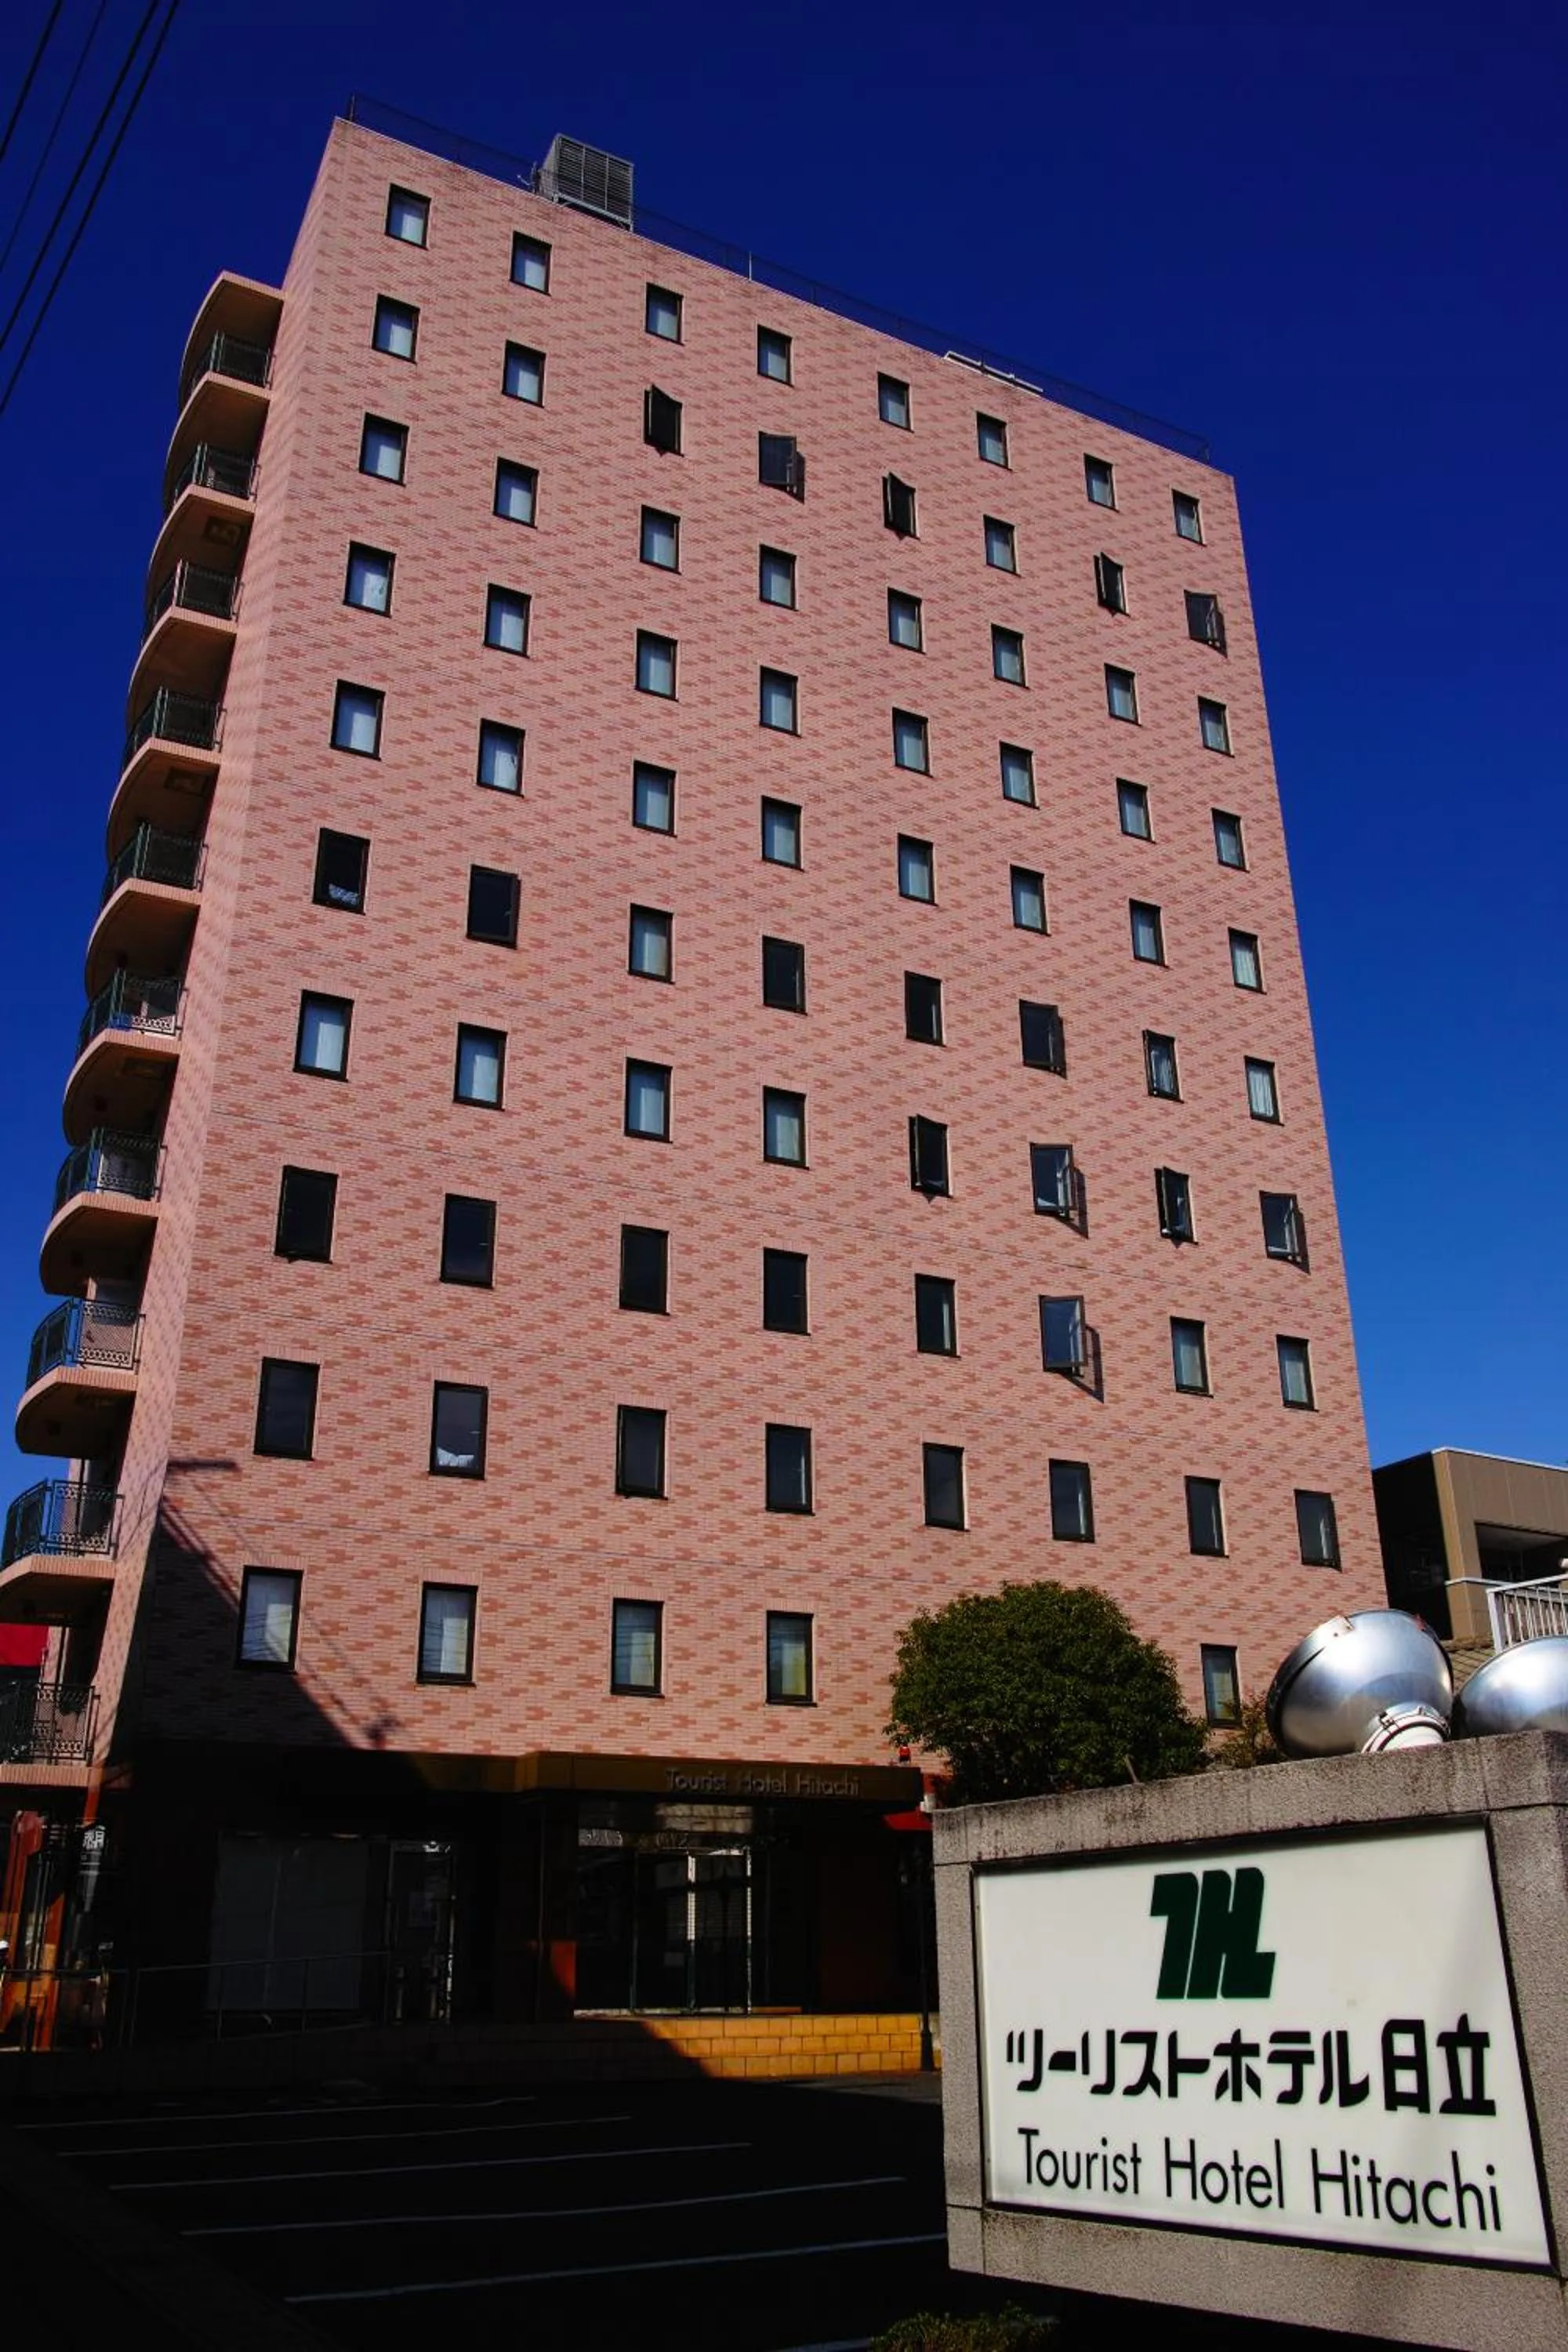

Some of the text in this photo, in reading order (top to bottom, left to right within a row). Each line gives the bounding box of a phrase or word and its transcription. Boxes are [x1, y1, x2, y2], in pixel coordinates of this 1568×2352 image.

[666, 1769, 728, 1791] Tourist
[797, 1769, 860, 1795] Hitachi
[1006, 2013, 1497, 2117] ツーリストホテル日立
[1018, 2127, 1501, 2231] Tourist Hotel Hitachi
